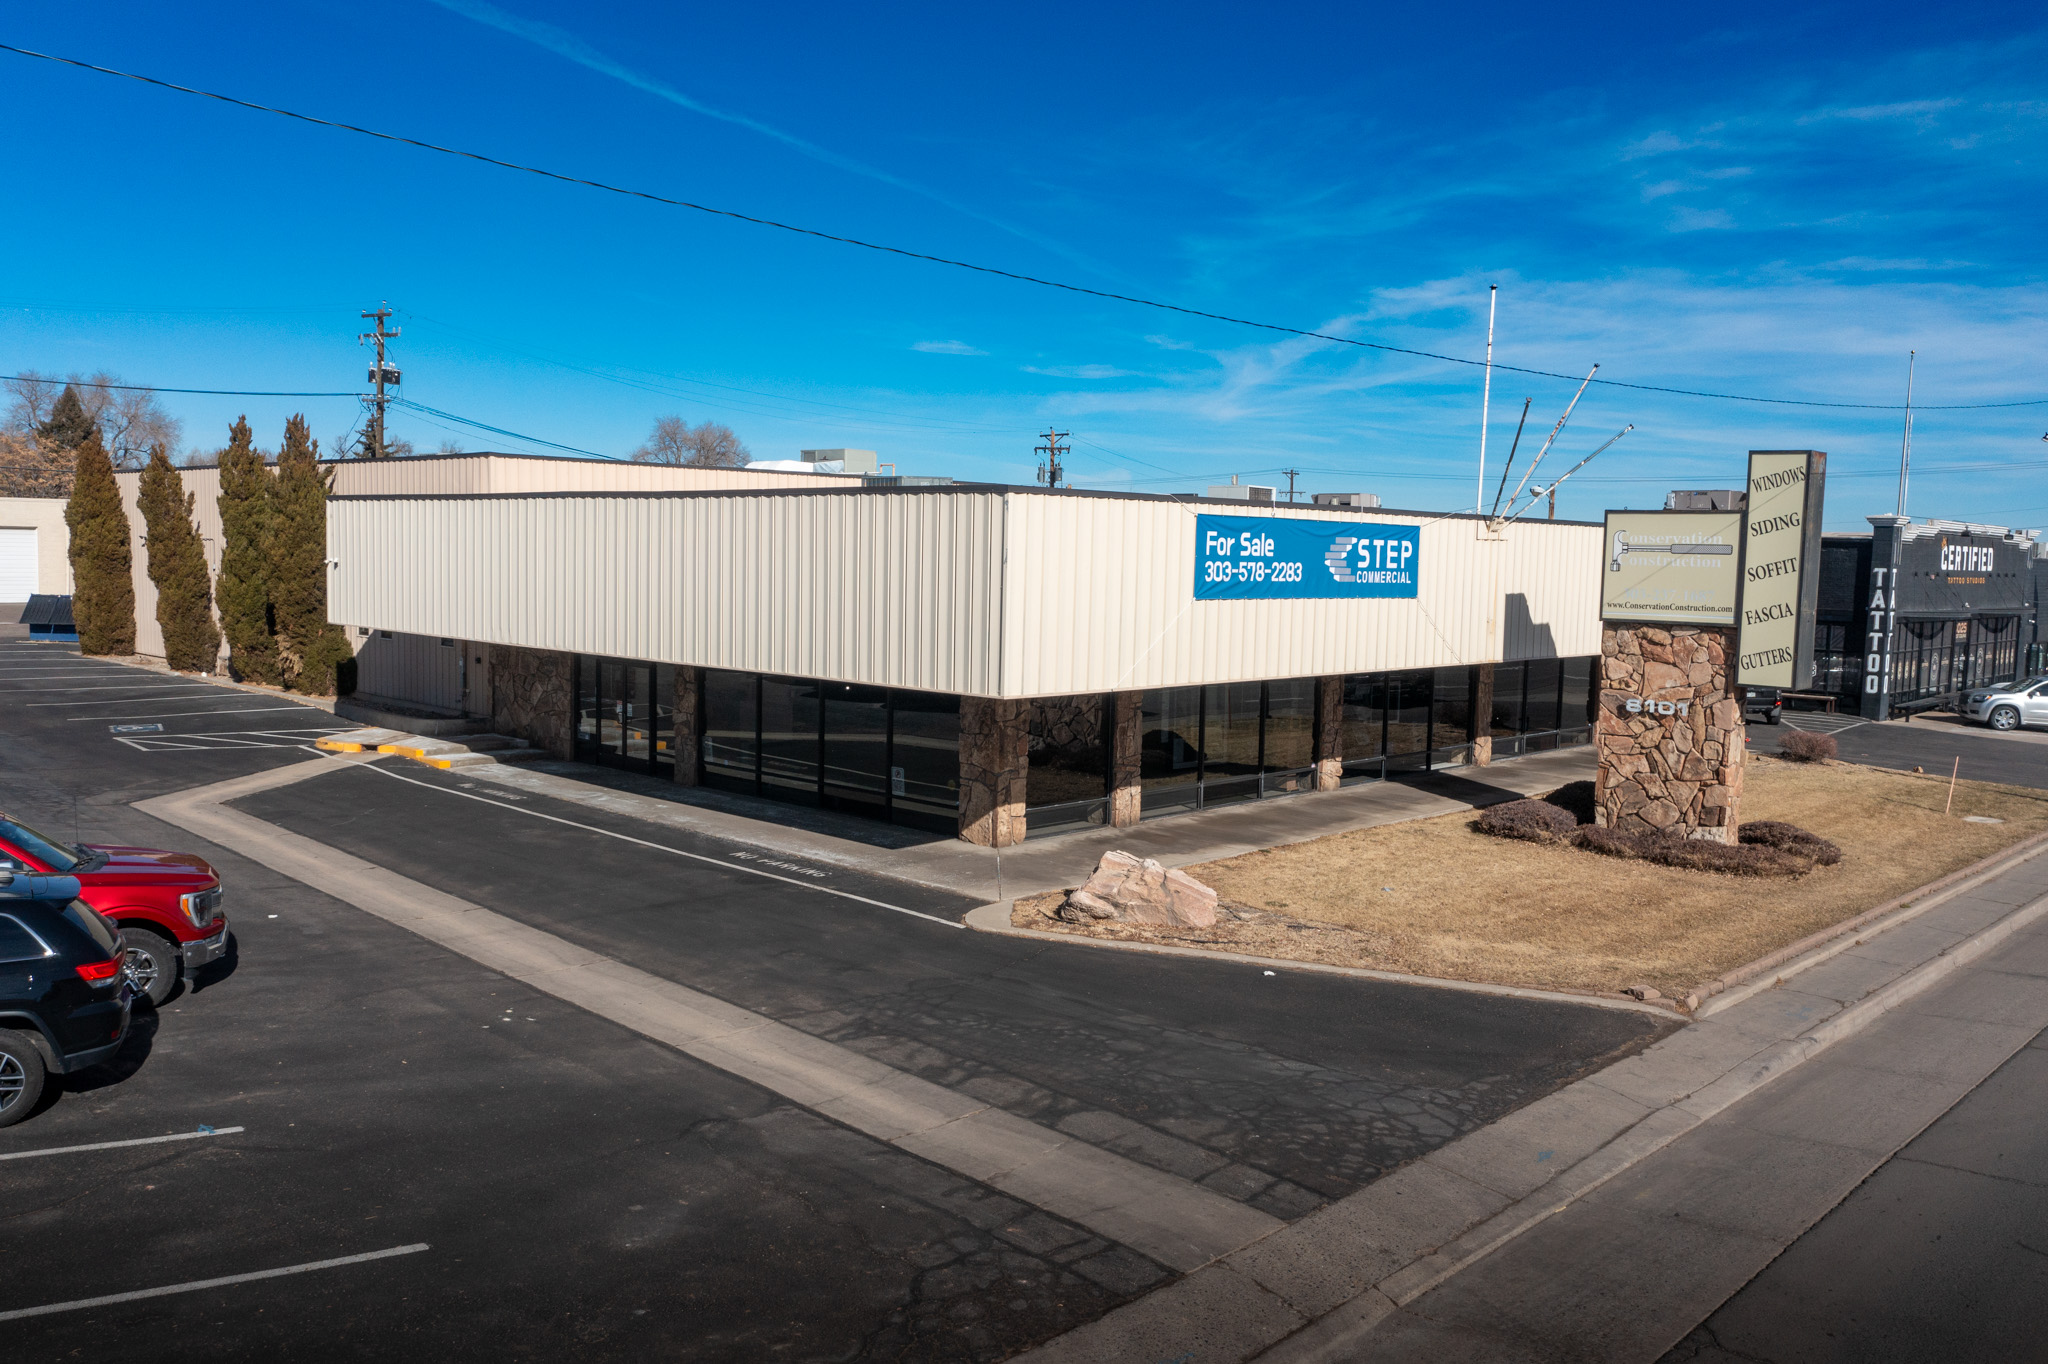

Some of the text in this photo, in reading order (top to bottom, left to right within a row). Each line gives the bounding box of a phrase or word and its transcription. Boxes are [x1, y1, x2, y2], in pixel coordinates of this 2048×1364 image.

[1752, 466, 1806, 493] WINDOWS
[1750, 512, 1800, 537] SIDING
[1206, 531, 1275, 557] For Sale
[1357, 538, 1413, 569] STEP
[1747, 557, 1798, 582] SOFFIT
[1941, 545, 1994, 571] CERTIFIED
[1204, 561, 1303, 583] 303-578-2283
[1356, 570, 1412, 584] COMMERCIAL
[1606, 601, 1733, 613] www.ConservationConstruction.com
[1745, 602, 1794, 626] FASCIA
[1865, 567, 1887, 694] TATTOO
[1883, 568, 1897, 694] TATTOO
[1740, 646, 1793, 671] GUTTERS
[1625, 698, 1688, 716] 8101
